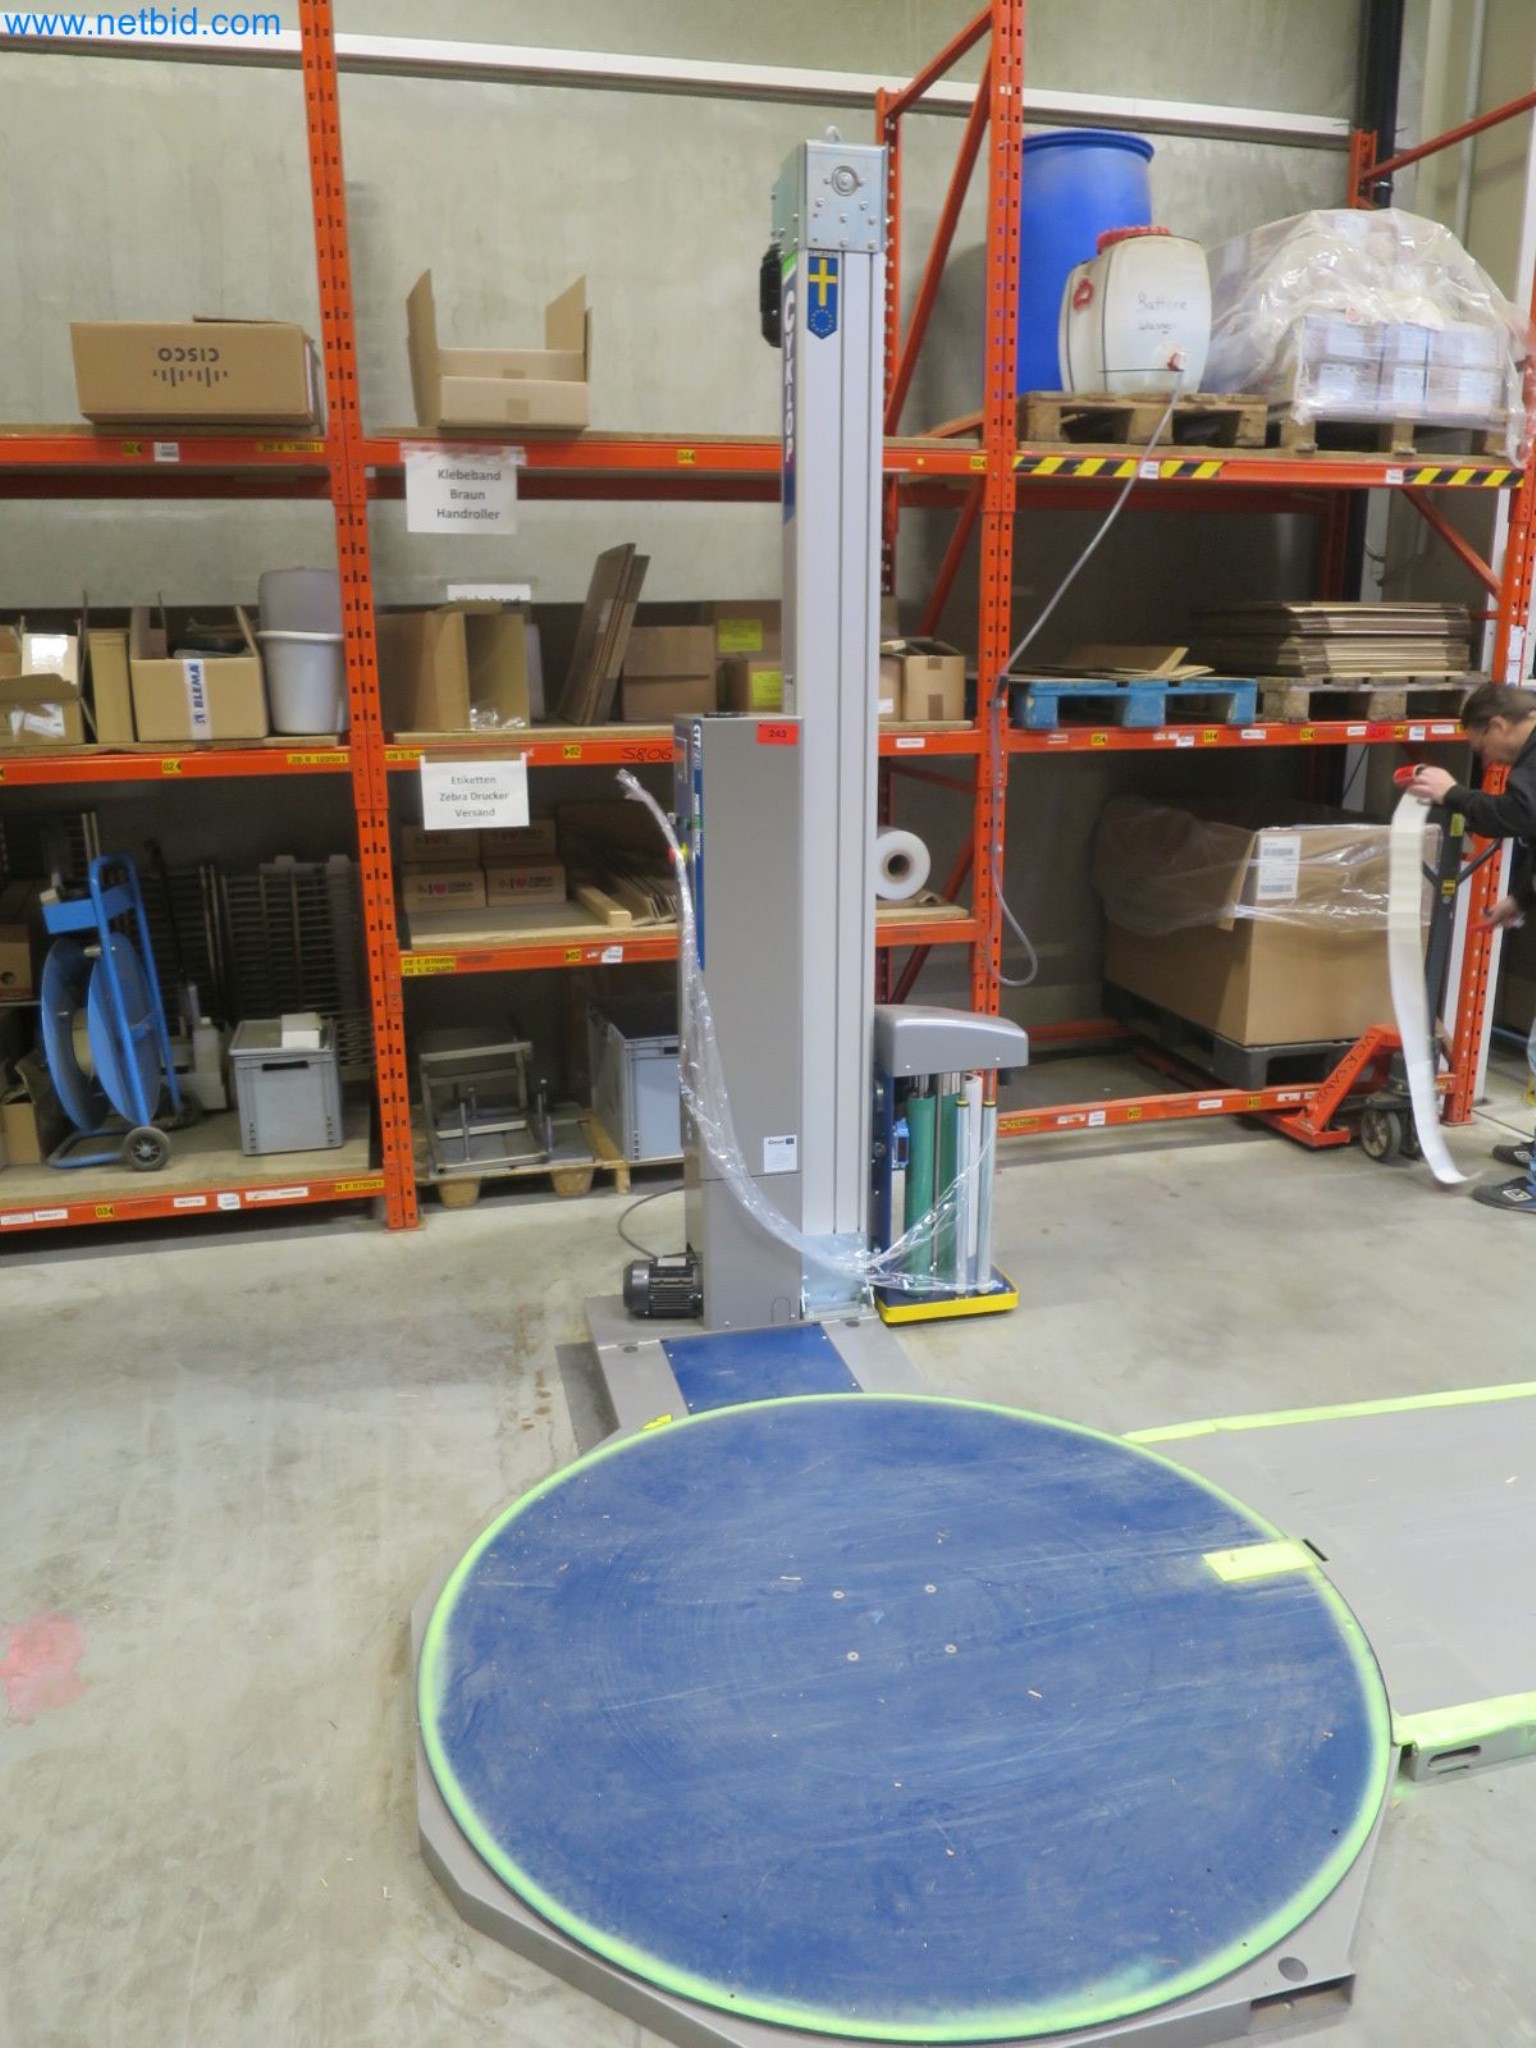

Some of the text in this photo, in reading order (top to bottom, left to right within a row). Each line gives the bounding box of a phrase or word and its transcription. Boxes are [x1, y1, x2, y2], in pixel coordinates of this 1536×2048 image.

[437, 468, 502, 481] Klebeband
[449, 488, 486, 500] Braun
[436, 507, 501, 520] Handroller
[451, 775, 497, 785] Etiketten
[439, 790, 510, 802] Zebra Drucker
[455, 807, 496, 818] Versand
